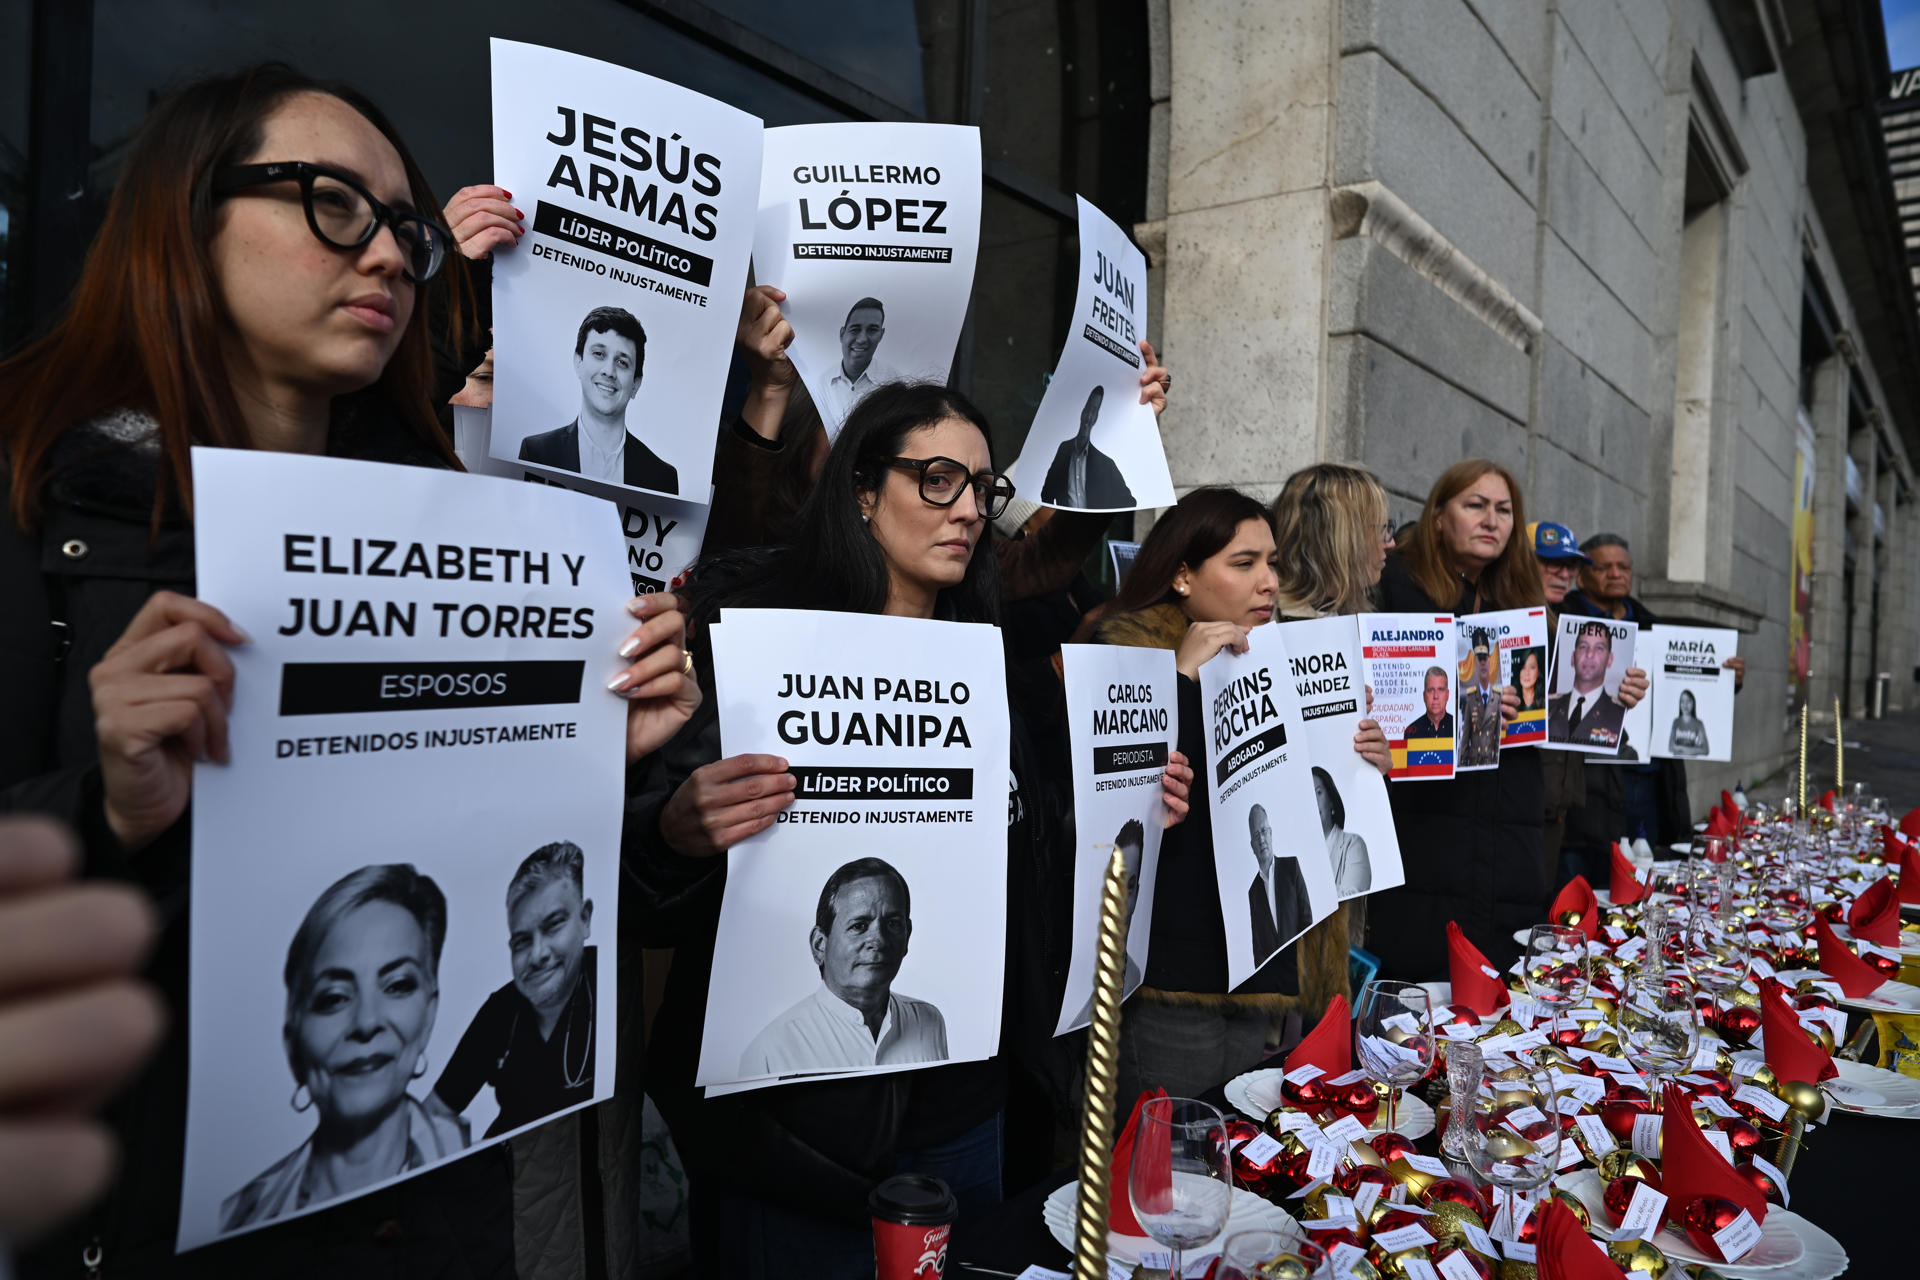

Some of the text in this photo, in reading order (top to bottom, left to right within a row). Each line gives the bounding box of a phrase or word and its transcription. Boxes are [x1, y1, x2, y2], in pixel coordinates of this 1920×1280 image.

[546, 105, 721, 197] JESÚS
[793, 165, 941, 186] GUILLERMO
[546, 154, 718, 242] ARMAS
[799, 189, 947, 234] LÓPEZ
[558, 217, 691, 274] LÍDER POLÍTICO
[798, 245, 948, 260] DETENIDO INJUSTAMENTE
[532, 243, 708, 308] DETENIDO INJUSTAMENTE
[1094, 250, 1134, 314] JUAN
[1092, 295, 1137, 346] FREITES
[1085, 327, 1109, 347] DETENIDO
[284, 533, 549, 586] ELIZABETH
[562, 554, 586, 586] Y
[278, 598, 594, 639] JUAN TORRES
[1371, 630, 1444, 642] ALEJANDRO
[1461, 624, 1496, 640] LIBAD
[1668, 639, 1716, 654] MARÍA
[1288, 651, 1347, 676] NORA
[1372, 663, 1411, 671] DETENIDO
[380, 672, 507, 699] ESPOSOS
[777, 674, 970, 704] JUAN PABLO
[1108, 684, 1152, 703] CARLOS
[1214, 667, 1272, 724] PERKINS
[1295, 675, 1351, 697] NÁNDEZ
[1374, 679, 1398, 687] DESDE
[1303, 701, 1354, 718] INJUSTAMENTE
[1371, 703, 1415, 713] CIUDADANO
[777, 710, 972, 748] GUANIPA
[1093, 708, 1168, 736] MARCANO
[1214, 694, 1279, 756] ROCHA
[1381, 725, 1417, 735] EZOLANO
[276, 722, 577, 759] DETENIDOS INJUSTAMENTE
[1113, 750, 1154, 765] PERIODISTA
[1227, 740, 1265, 773] ABOGADO
[803, 772, 950, 793] LÍDER POLÍTICO
[1096, 778, 1127, 792] DETENIDO
[1219, 753, 1288, 805] DETENIDO INJUSTAMENTE
[777, 810, 973, 824] DETENIDO INJUSTAMENTE
